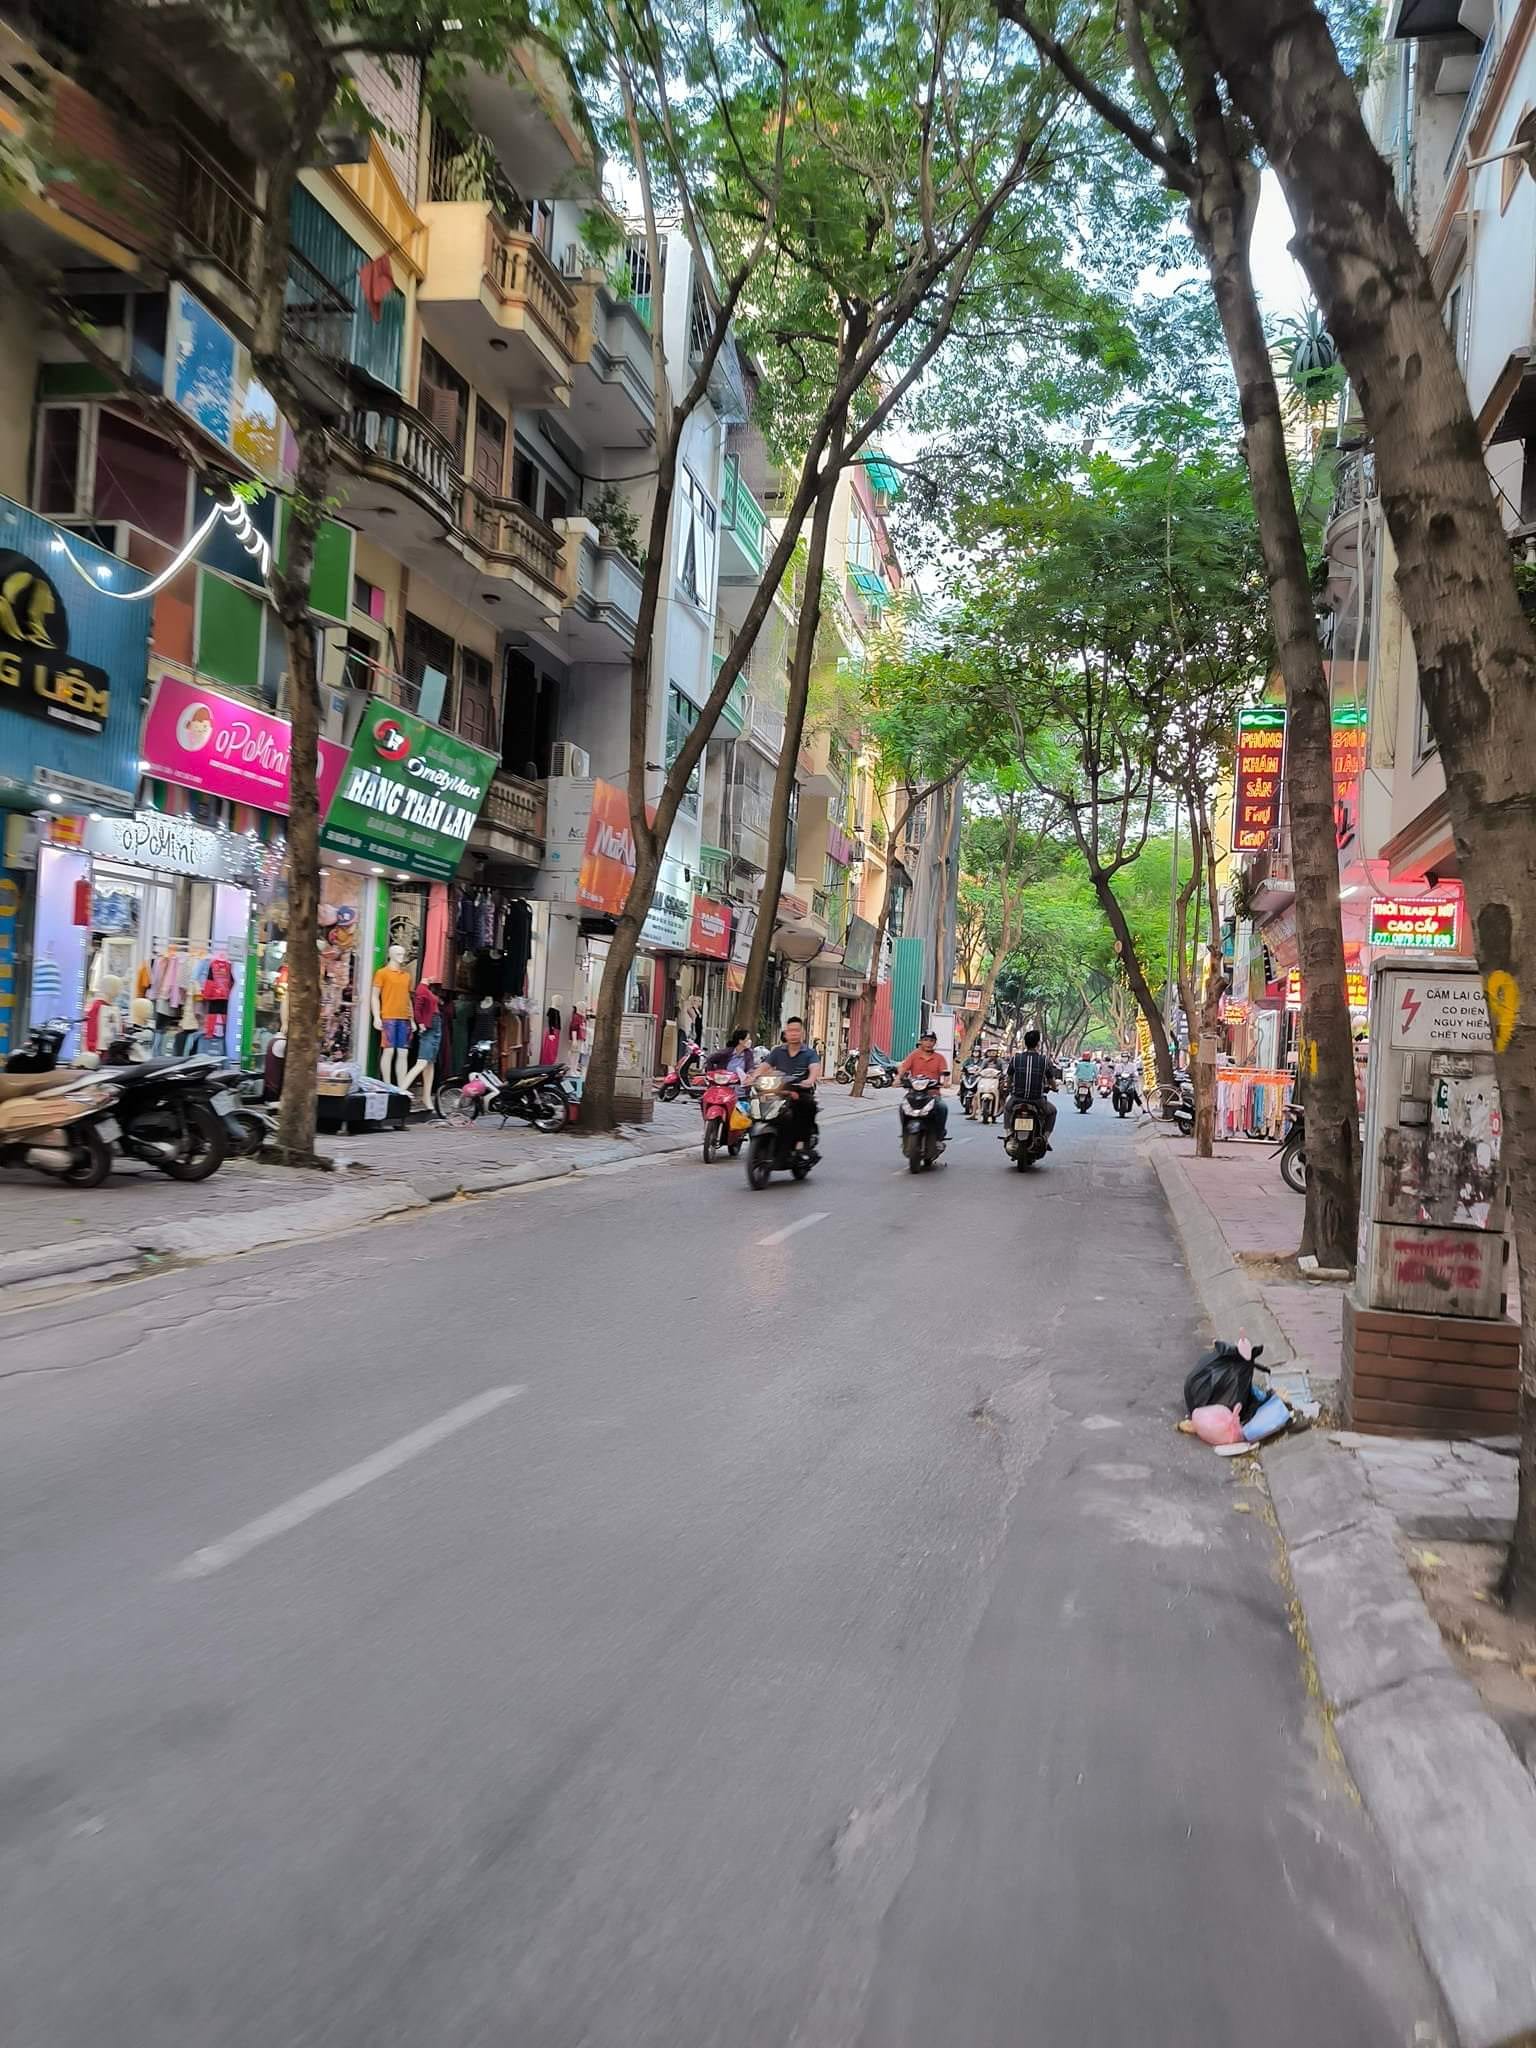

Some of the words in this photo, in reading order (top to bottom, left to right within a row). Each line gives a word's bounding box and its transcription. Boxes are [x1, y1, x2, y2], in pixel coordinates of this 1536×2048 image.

[343, 766, 404, 815] HÀNG
[402, 790, 447, 830] THÁI
[440, 803, 478, 842] LAN
[1387, 919, 1414, 933] CAO
[1434, 1018, 1464, 1027] NGUY
